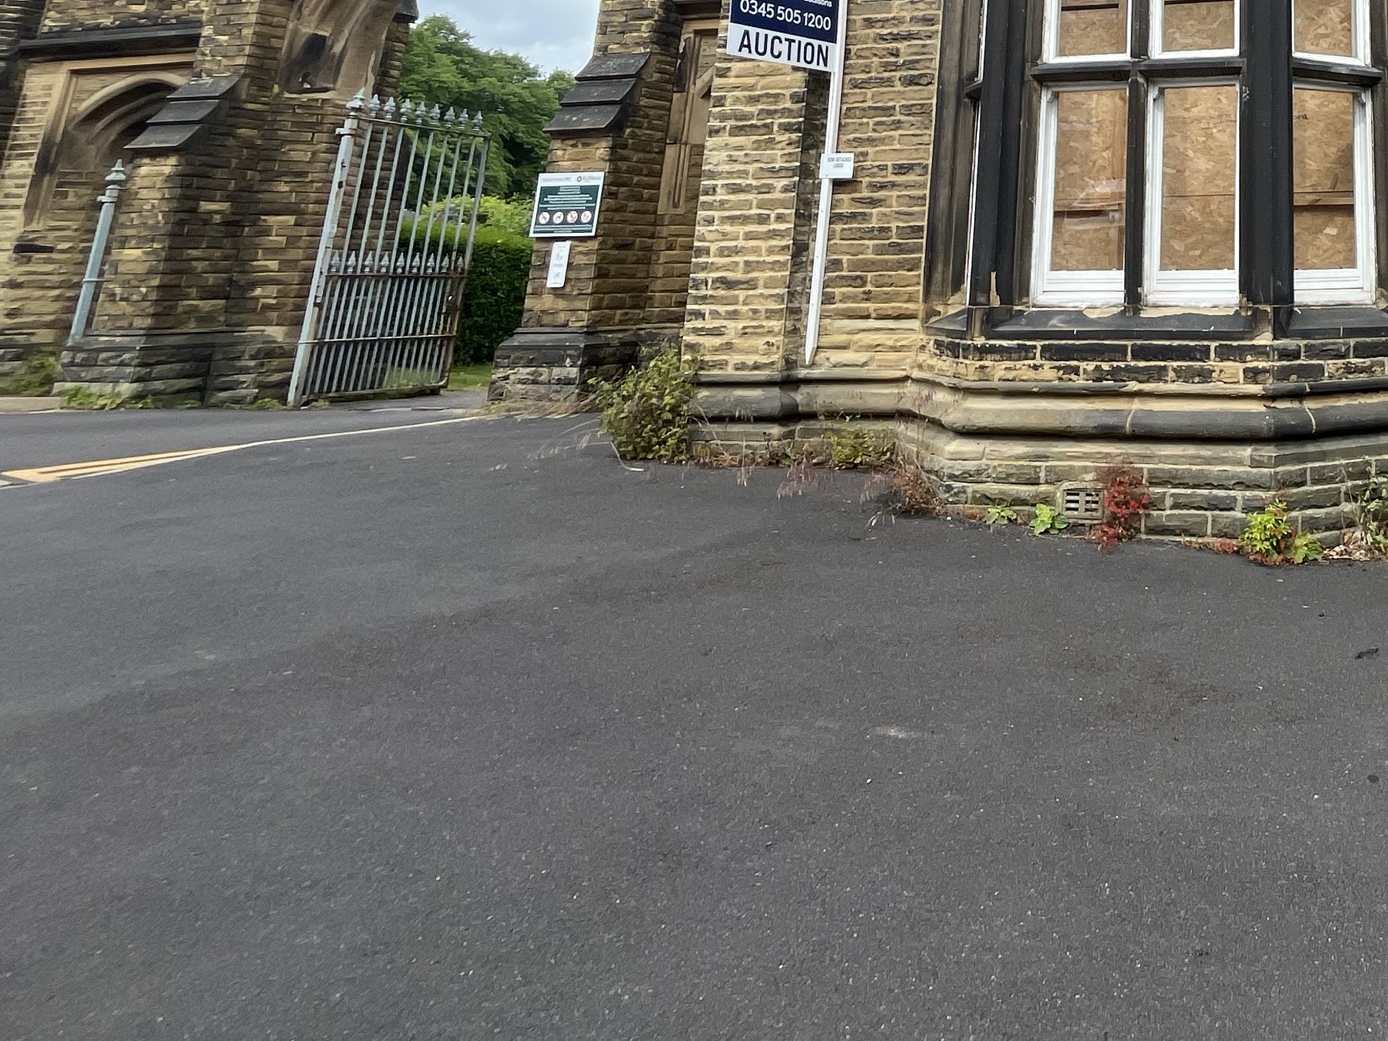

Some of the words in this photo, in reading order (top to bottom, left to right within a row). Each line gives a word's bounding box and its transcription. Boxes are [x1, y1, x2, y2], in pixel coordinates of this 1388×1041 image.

[776, 6, 801, 24] 505
[803, 12, 831, 30] 1200
[738, 29, 829, 67] AUCTION
